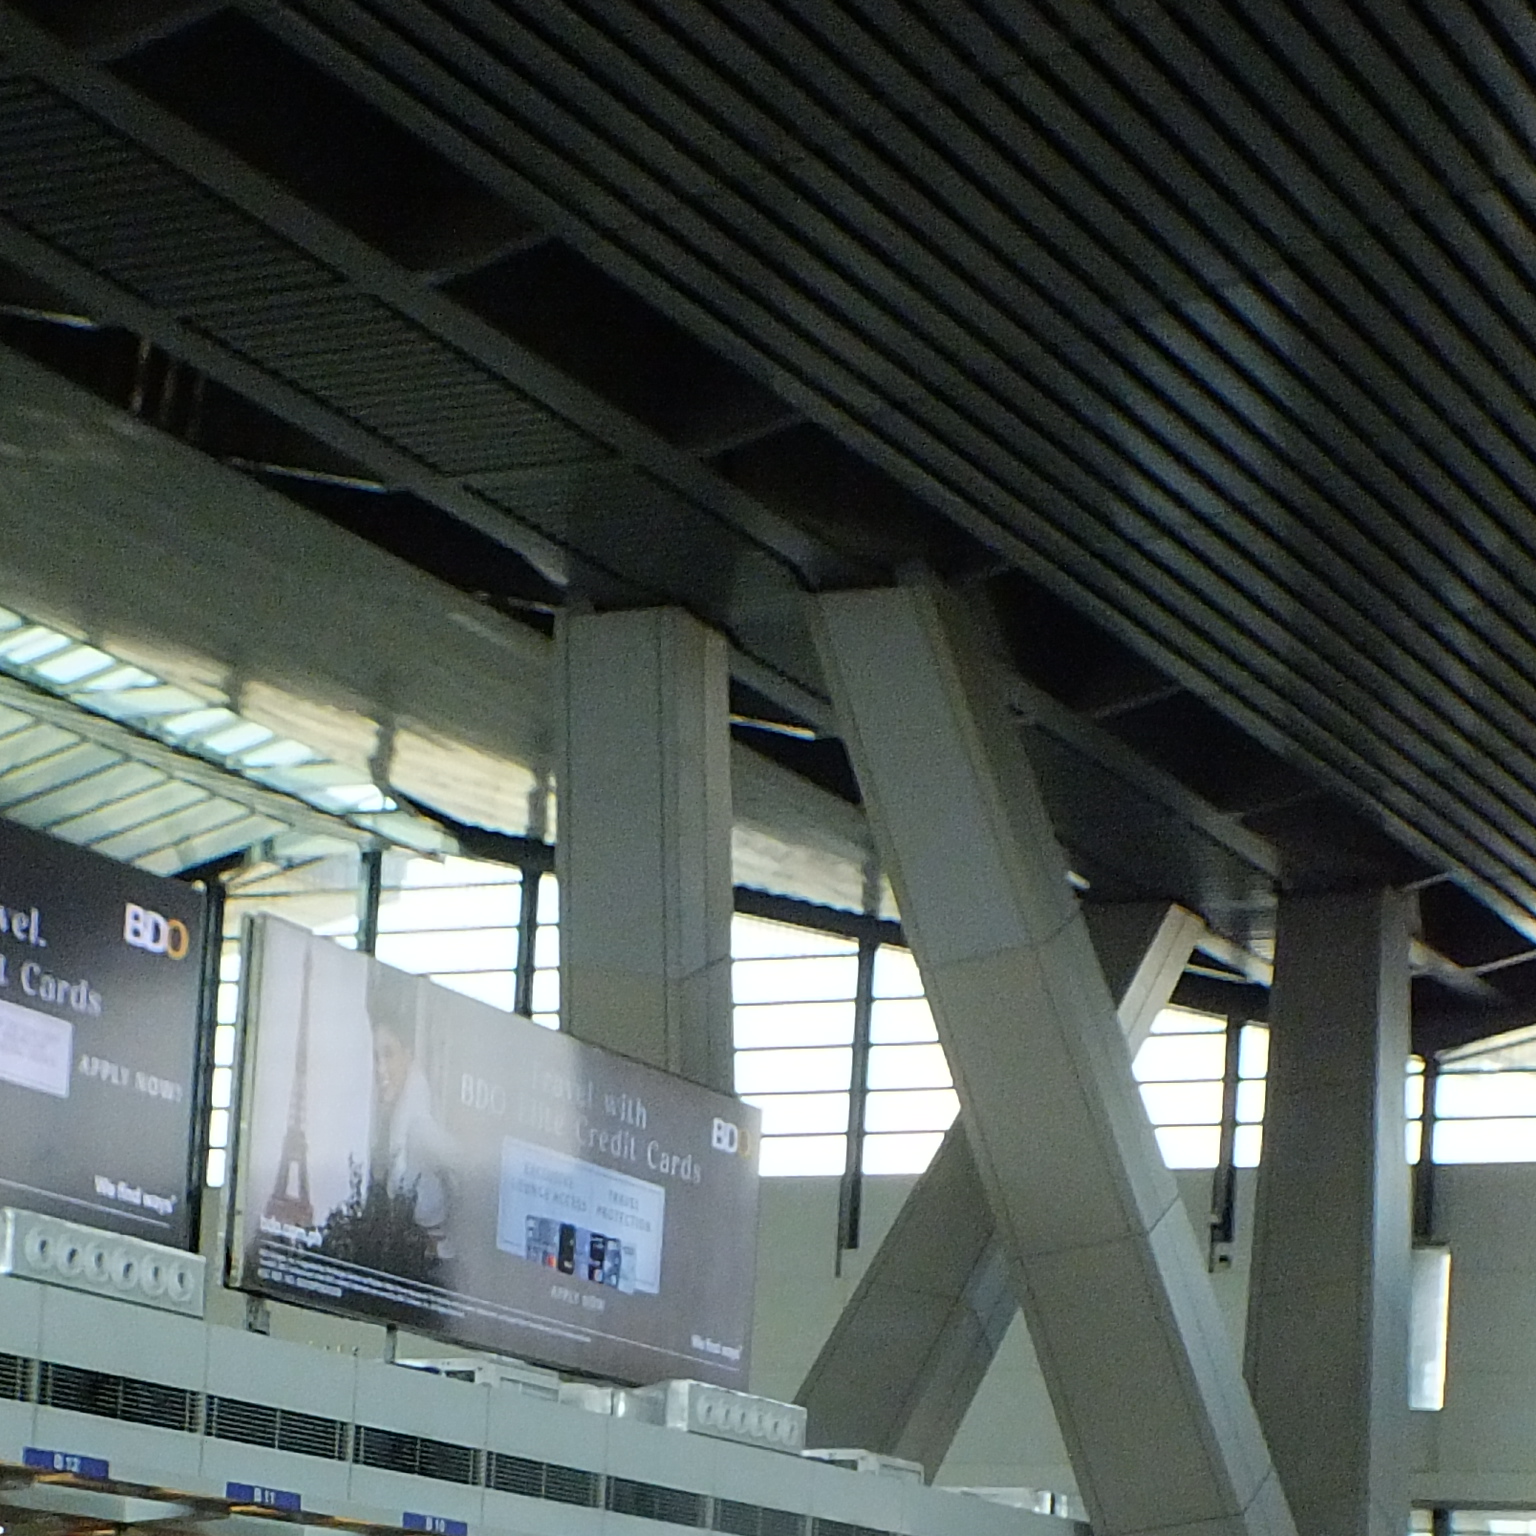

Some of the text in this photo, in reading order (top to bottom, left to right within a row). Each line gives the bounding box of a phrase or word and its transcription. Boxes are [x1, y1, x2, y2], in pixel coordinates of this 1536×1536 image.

[123, 902, 189, 961] BDO
[20, 961, 102, 1017] Cards
[79, 1053, 130, 1086] APPLY
[461, 1073, 506, 1115] BDO
[575, 1115, 637, 1162] Credit
[646, 1140, 702, 1184] Cards
[604, 1094, 647, 1130] with
[711, 1117, 751, 1160] BDO
